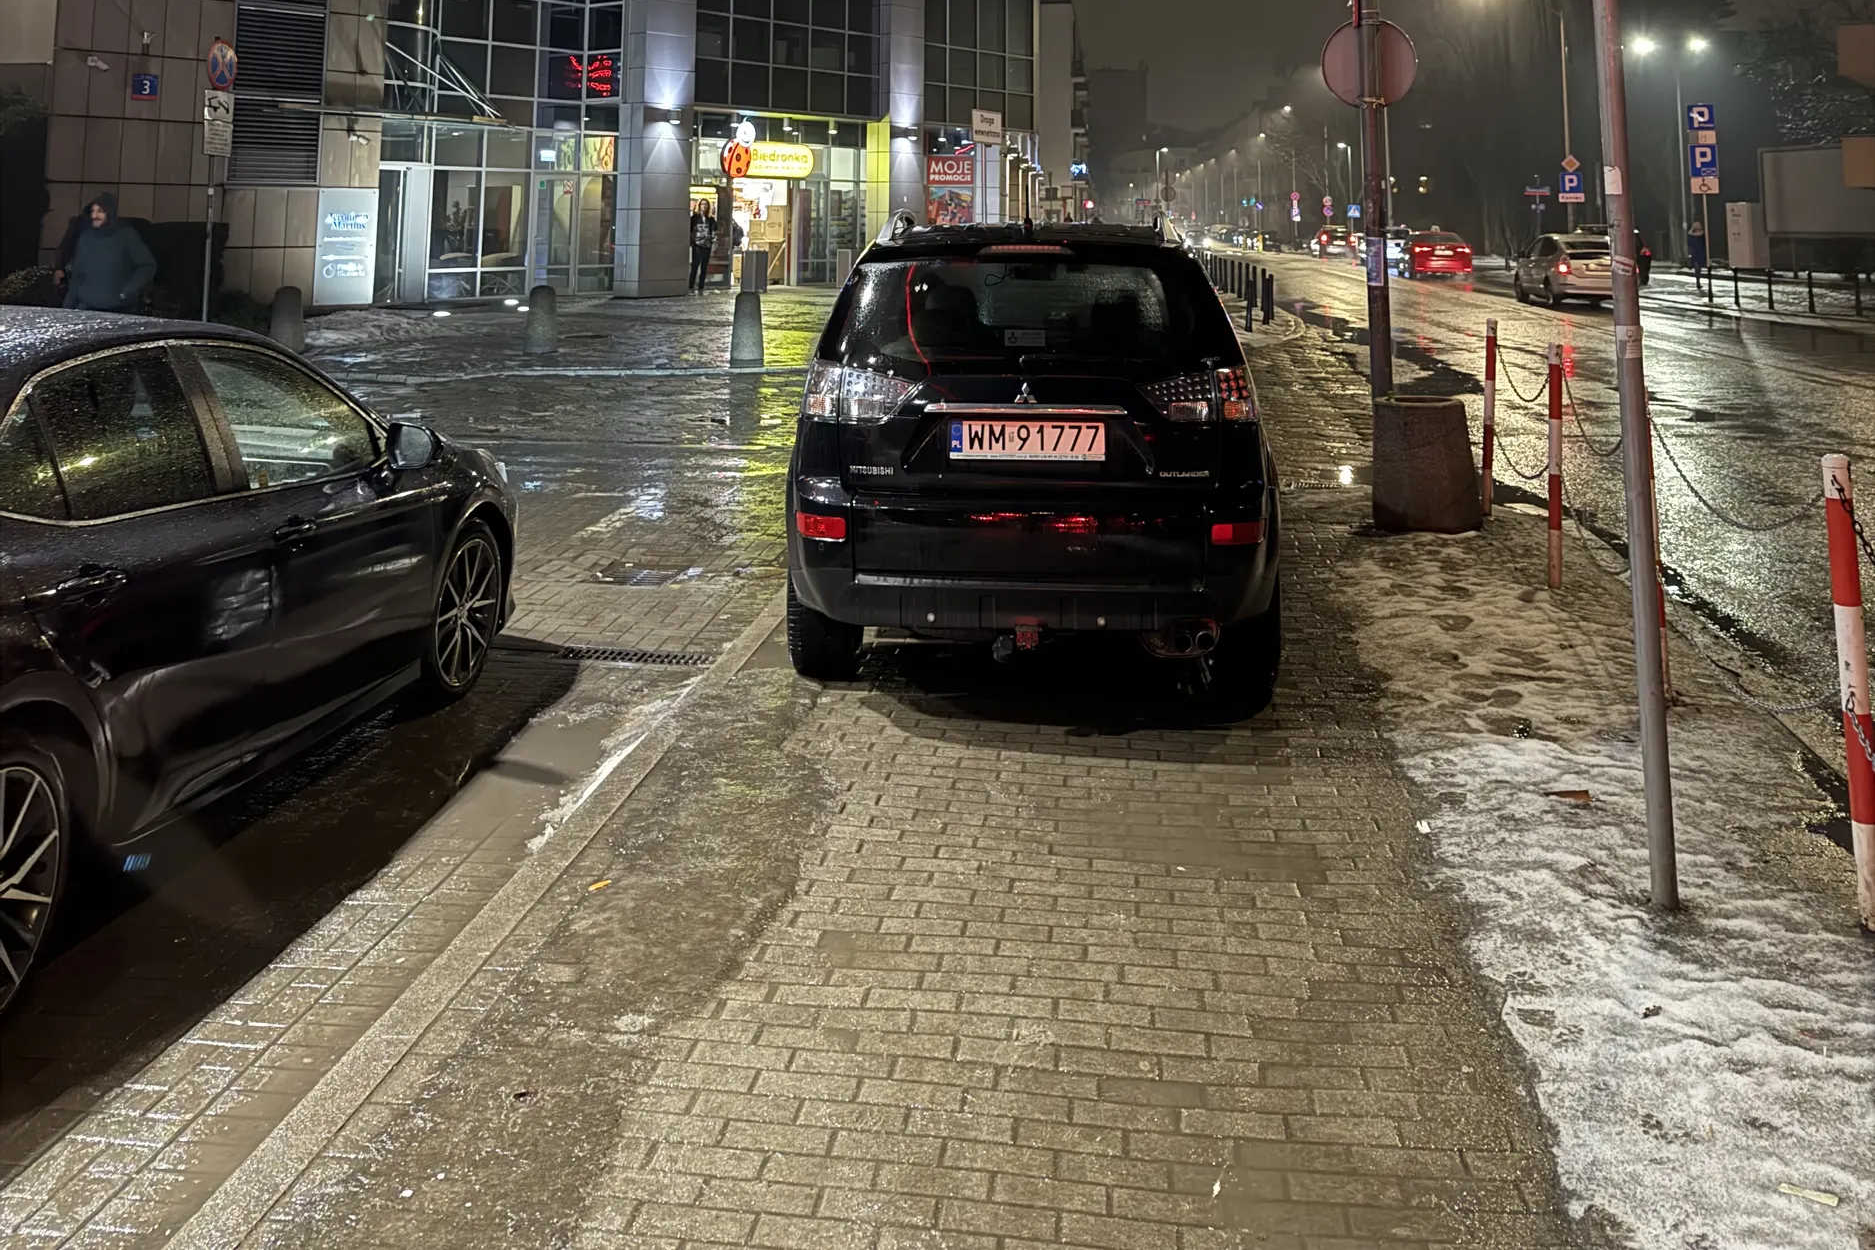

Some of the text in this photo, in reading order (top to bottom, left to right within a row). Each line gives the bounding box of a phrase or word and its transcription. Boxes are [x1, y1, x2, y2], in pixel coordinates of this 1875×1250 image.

[141, 80, 150, 94] 3
[980, 114, 995, 126] Droga
[1692, 106, 1709, 128] P
[752, 148, 808, 164] Biedronka
[1695, 147, 1712, 168] P
[929, 160, 972, 174] MOJE
[929, 174, 972, 182] PROMOCJE
[1564, 175, 1578, 191] P
[330, 221, 367, 230] Martins
[951, 440, 962, 449] PL
[967, 423, 1100, 452] WM 91777
[849, 465, 894, 475] MITSUBISHI
[1159, 470, 1210, 478] OUTLANDER
